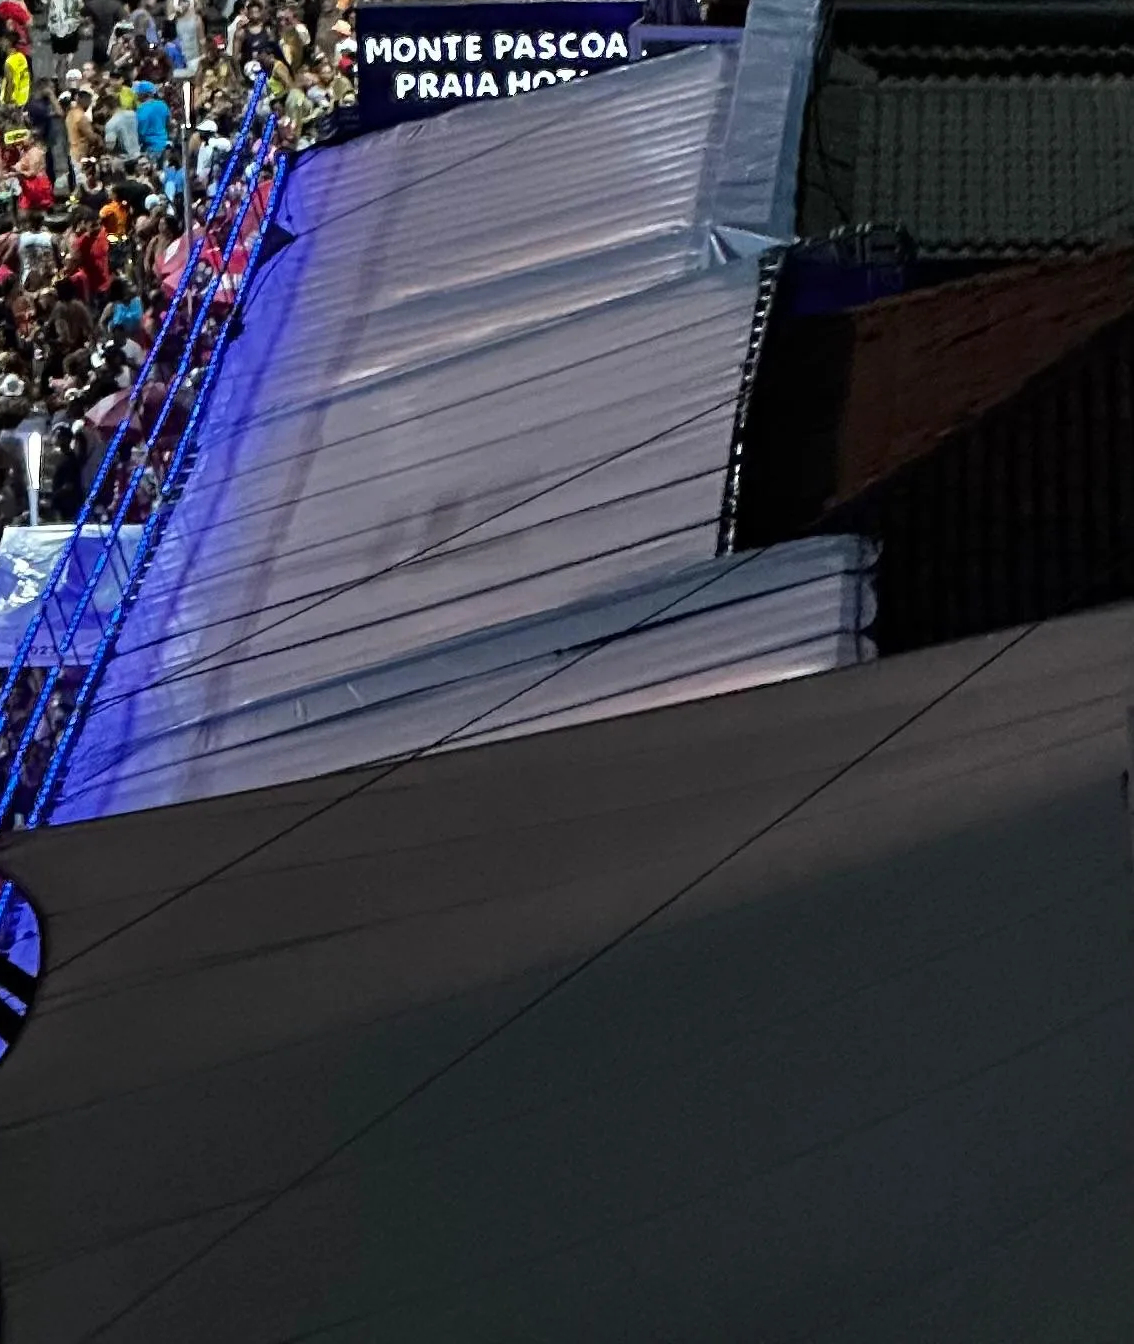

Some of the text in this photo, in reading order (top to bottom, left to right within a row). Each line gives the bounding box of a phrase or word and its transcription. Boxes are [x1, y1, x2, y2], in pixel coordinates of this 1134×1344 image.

[364, 31, 648, 64] MONTE PASCOA
[396, 68, 589, 99] PRAIA HOT
